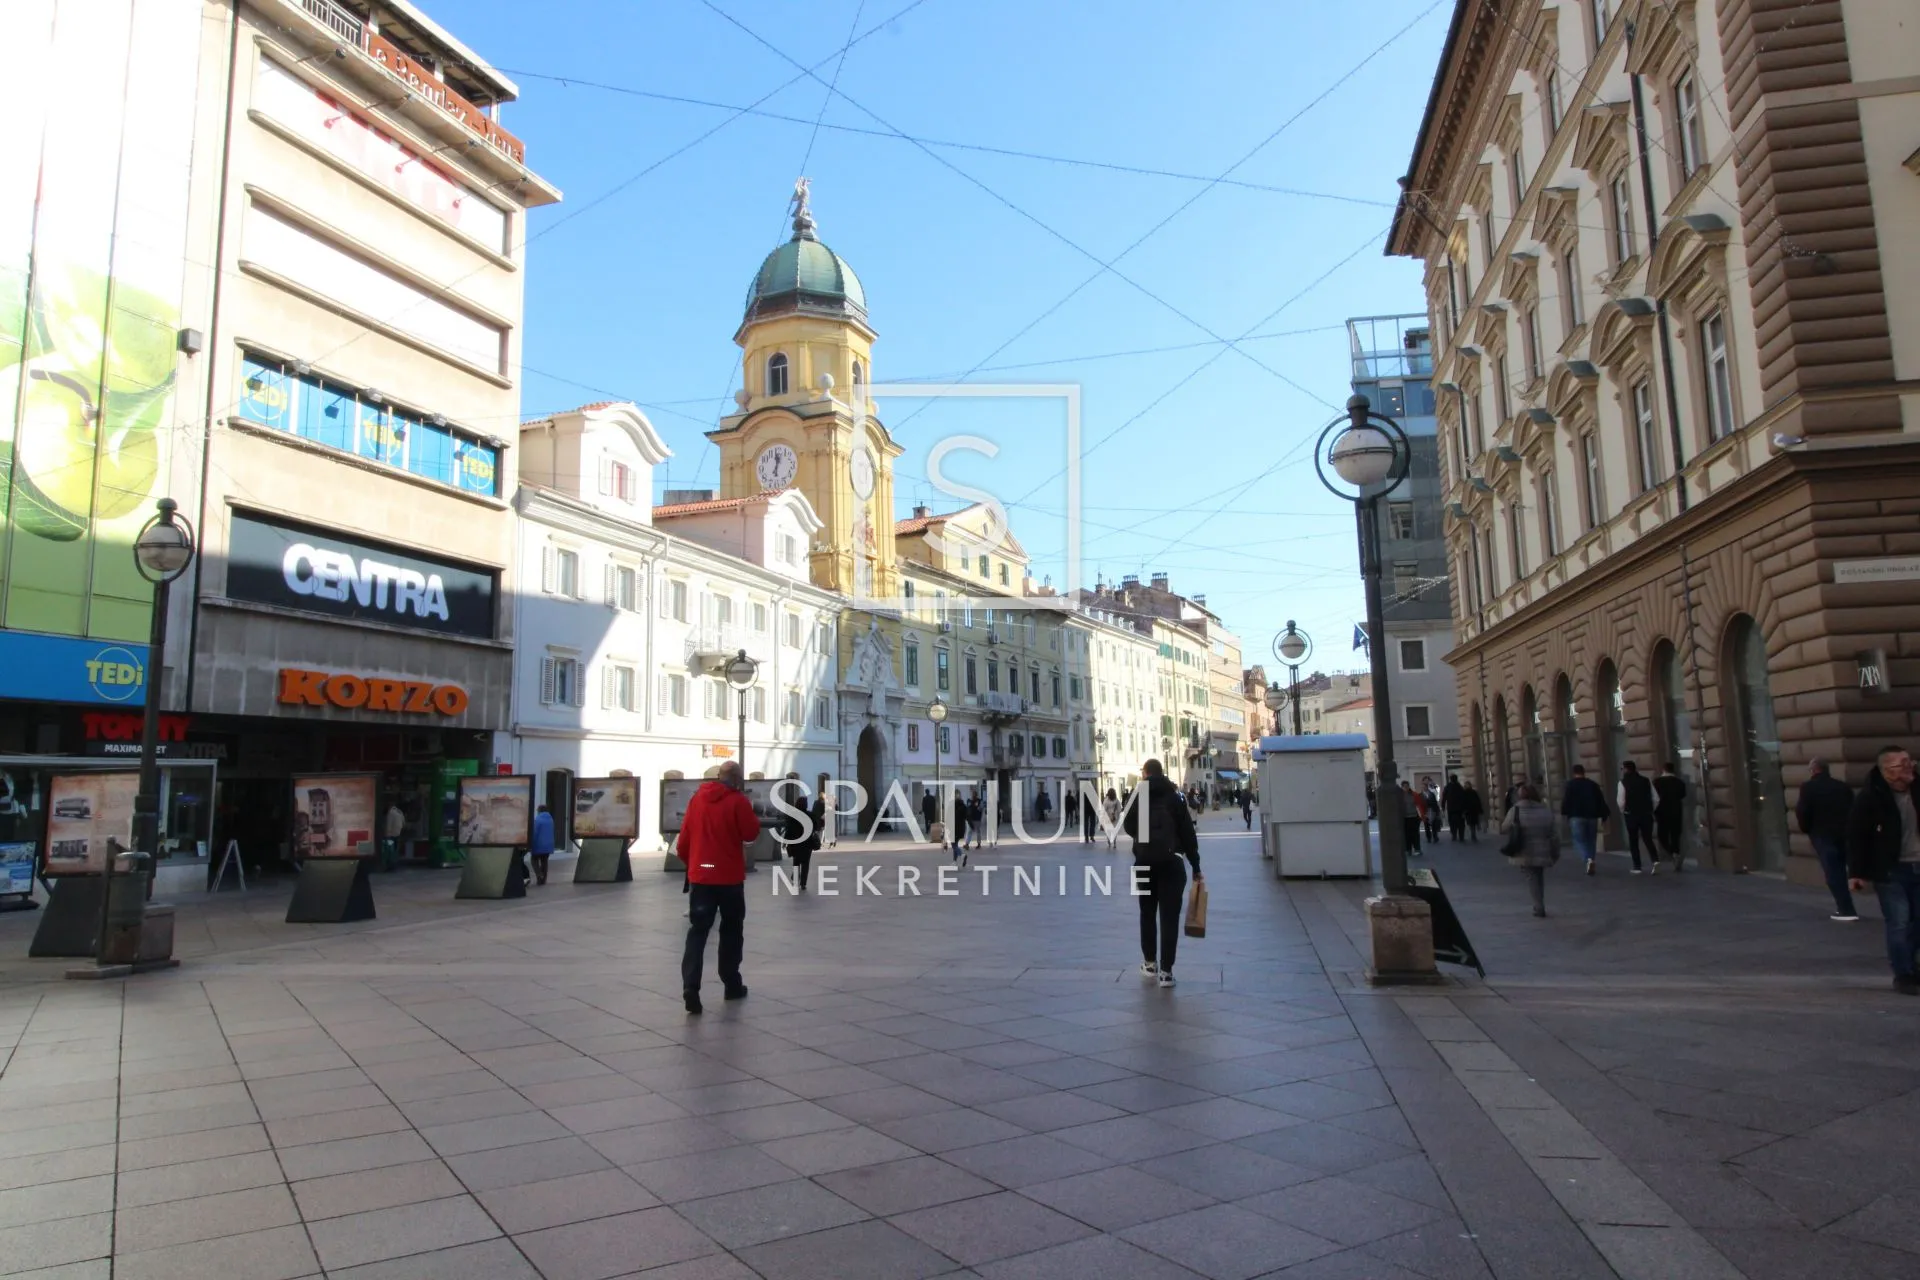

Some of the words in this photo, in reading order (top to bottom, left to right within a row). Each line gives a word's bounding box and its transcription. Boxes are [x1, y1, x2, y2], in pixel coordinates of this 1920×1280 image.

[283, 543, 449, 621] CENTRA
[86, 660, 143, 686] TEDi
[277, 668, 469, 716] KORZO
[104, 744, 167, 754] MAXIMAET
